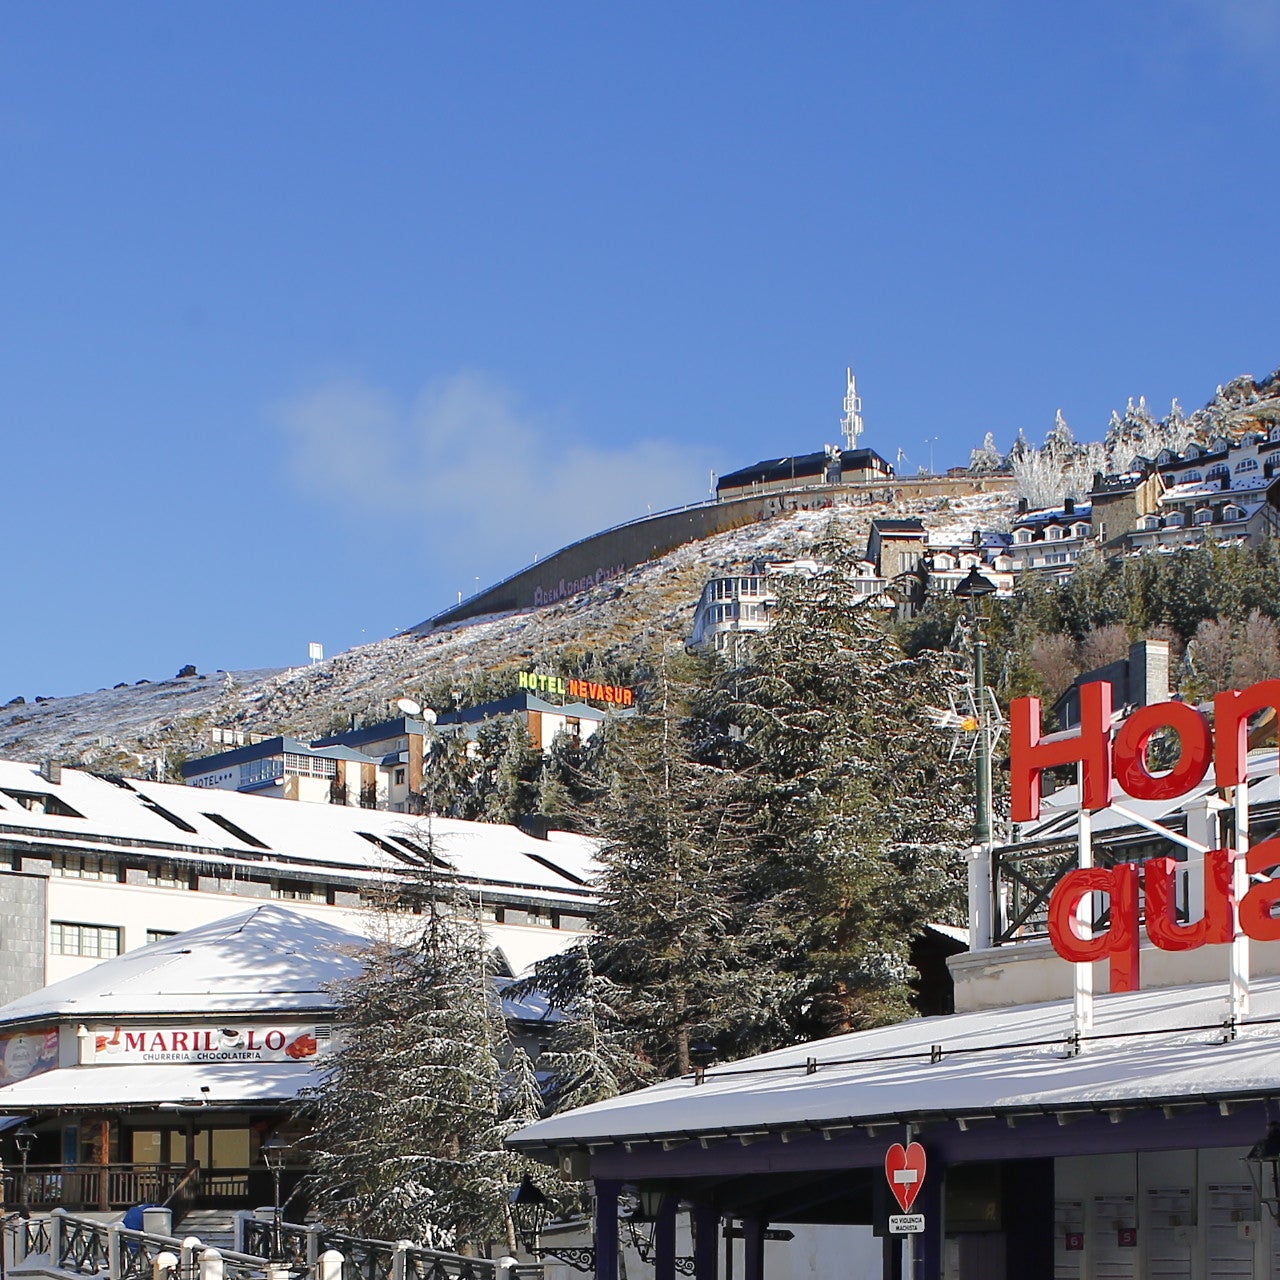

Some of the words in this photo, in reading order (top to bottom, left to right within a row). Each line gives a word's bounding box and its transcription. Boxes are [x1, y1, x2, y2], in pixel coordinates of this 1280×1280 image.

[519, 671, 566, 695] HOTEL
[569, 679, 634, 705] NEVASUR
[142, 1053, 190, 1061] CHURRERIA
[197, 1052, 261, 1060] CHOCOLATERIA
[1071, 1237, 1078, 1246] 6
[1123, 1232, 1131, 1242] 5
